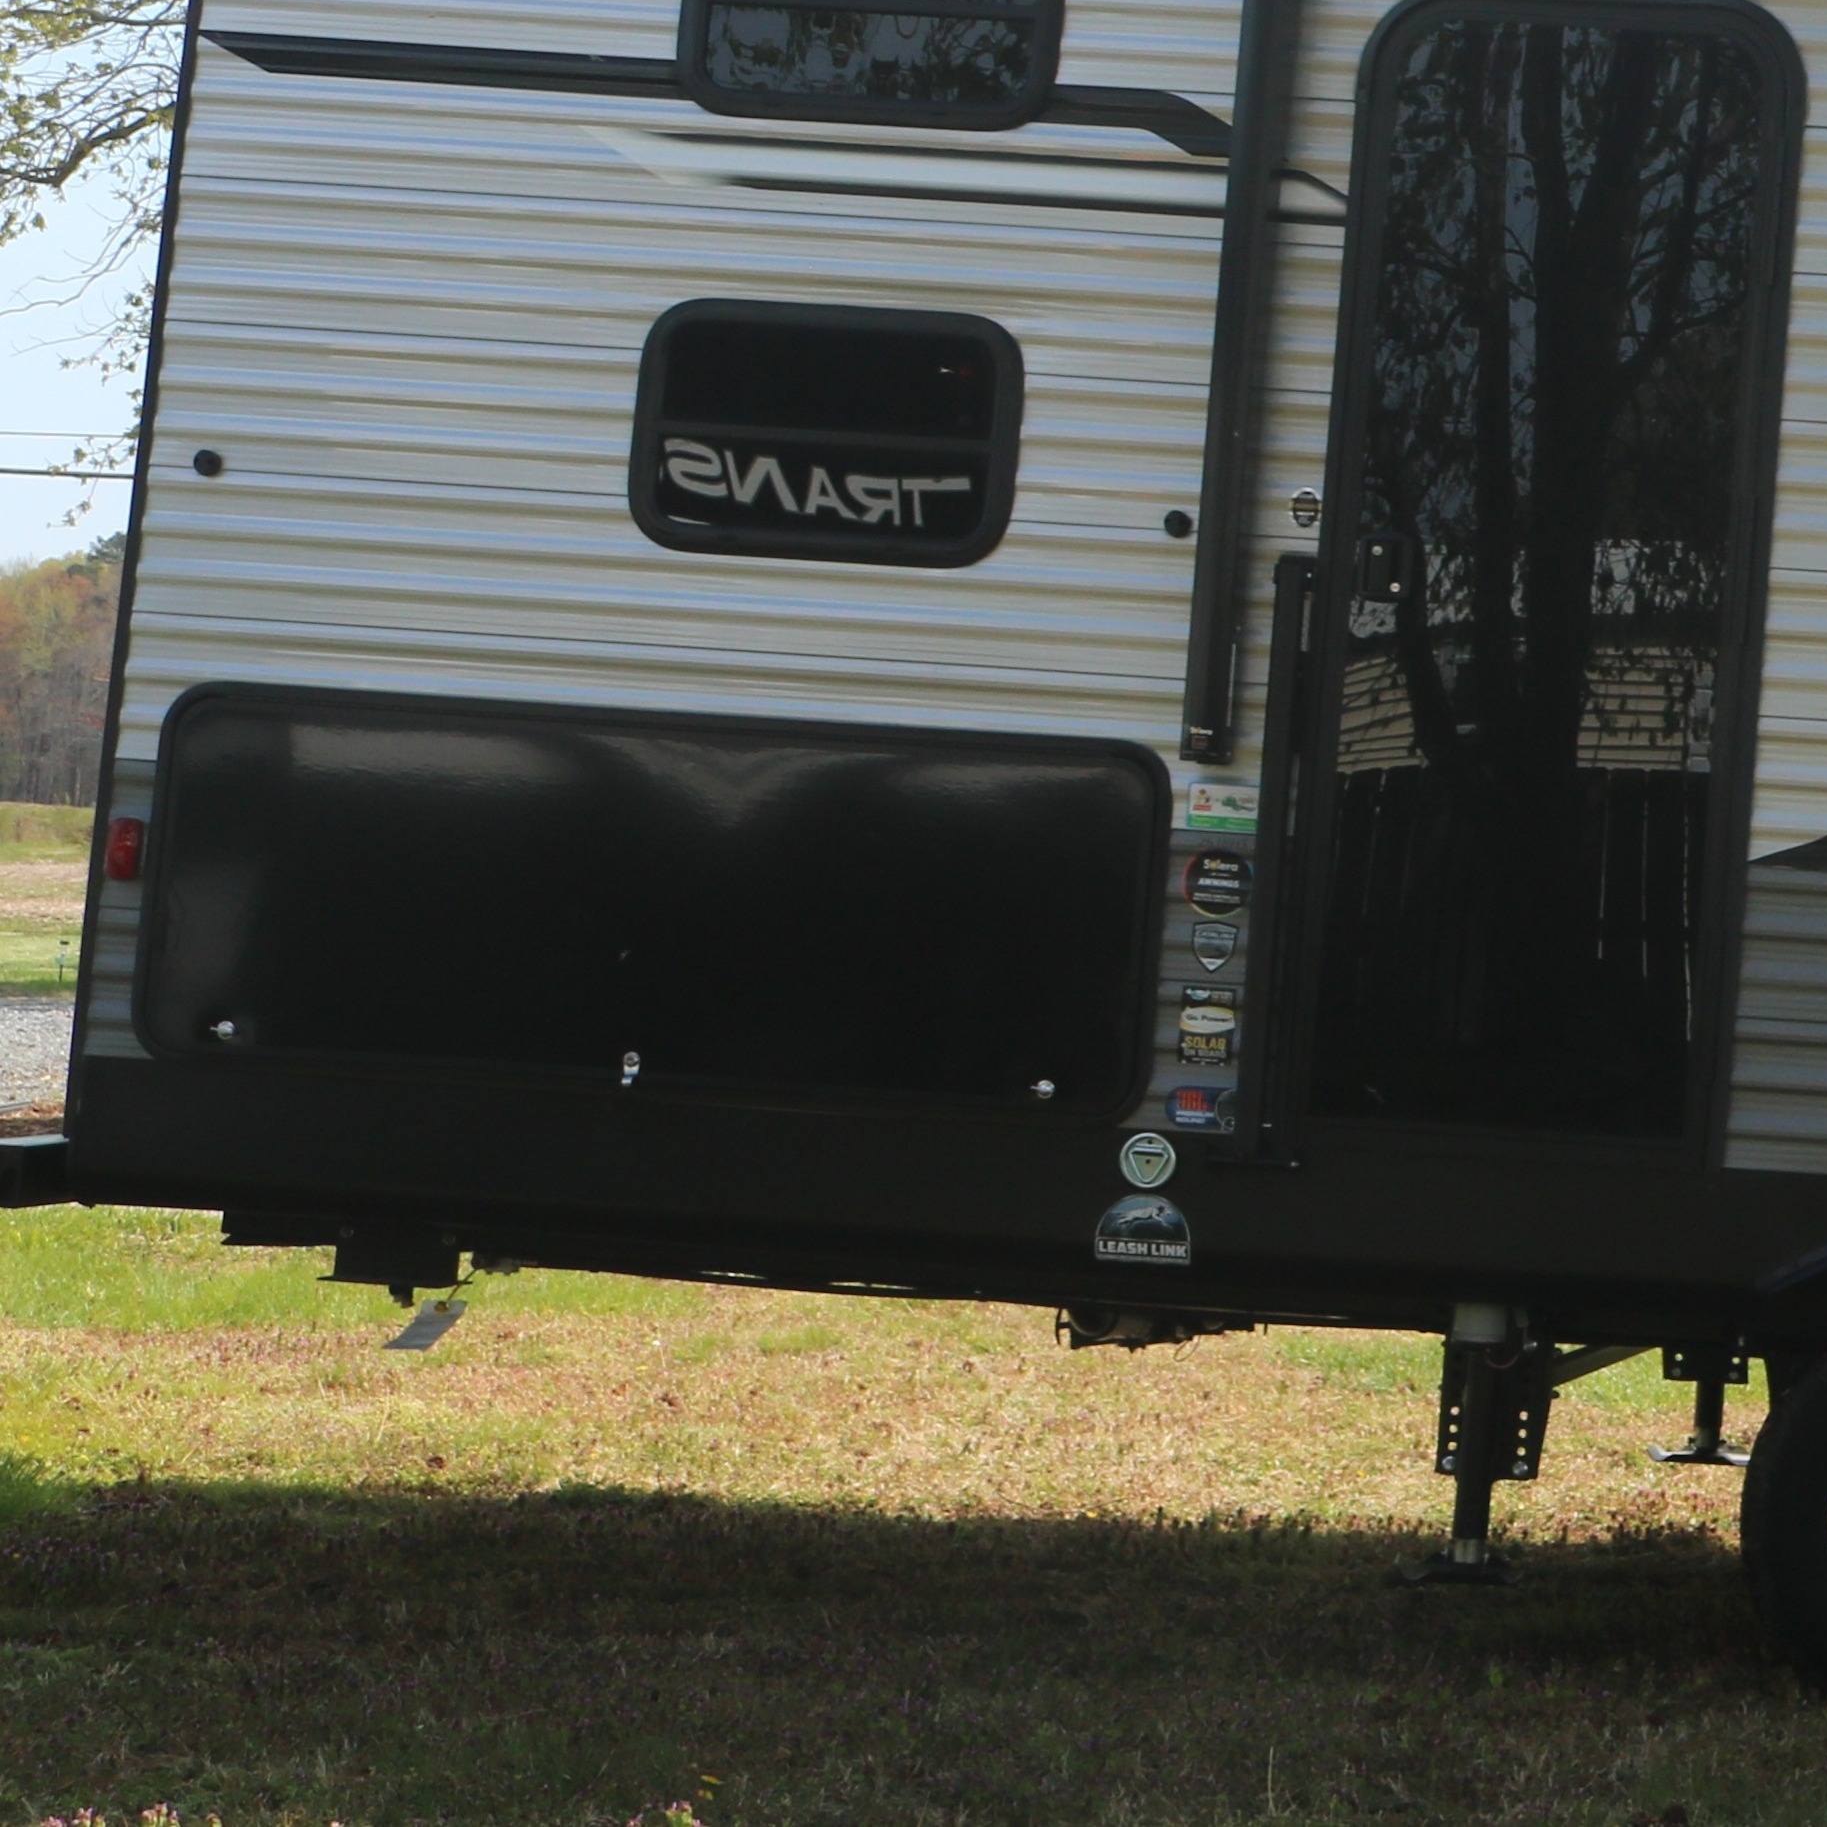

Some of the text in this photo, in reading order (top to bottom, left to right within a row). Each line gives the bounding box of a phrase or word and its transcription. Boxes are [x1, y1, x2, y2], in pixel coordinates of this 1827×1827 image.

[1203, 858, 1239, 872] Solera
[1098, 1240, 1187, 1257] LEASH LINK
